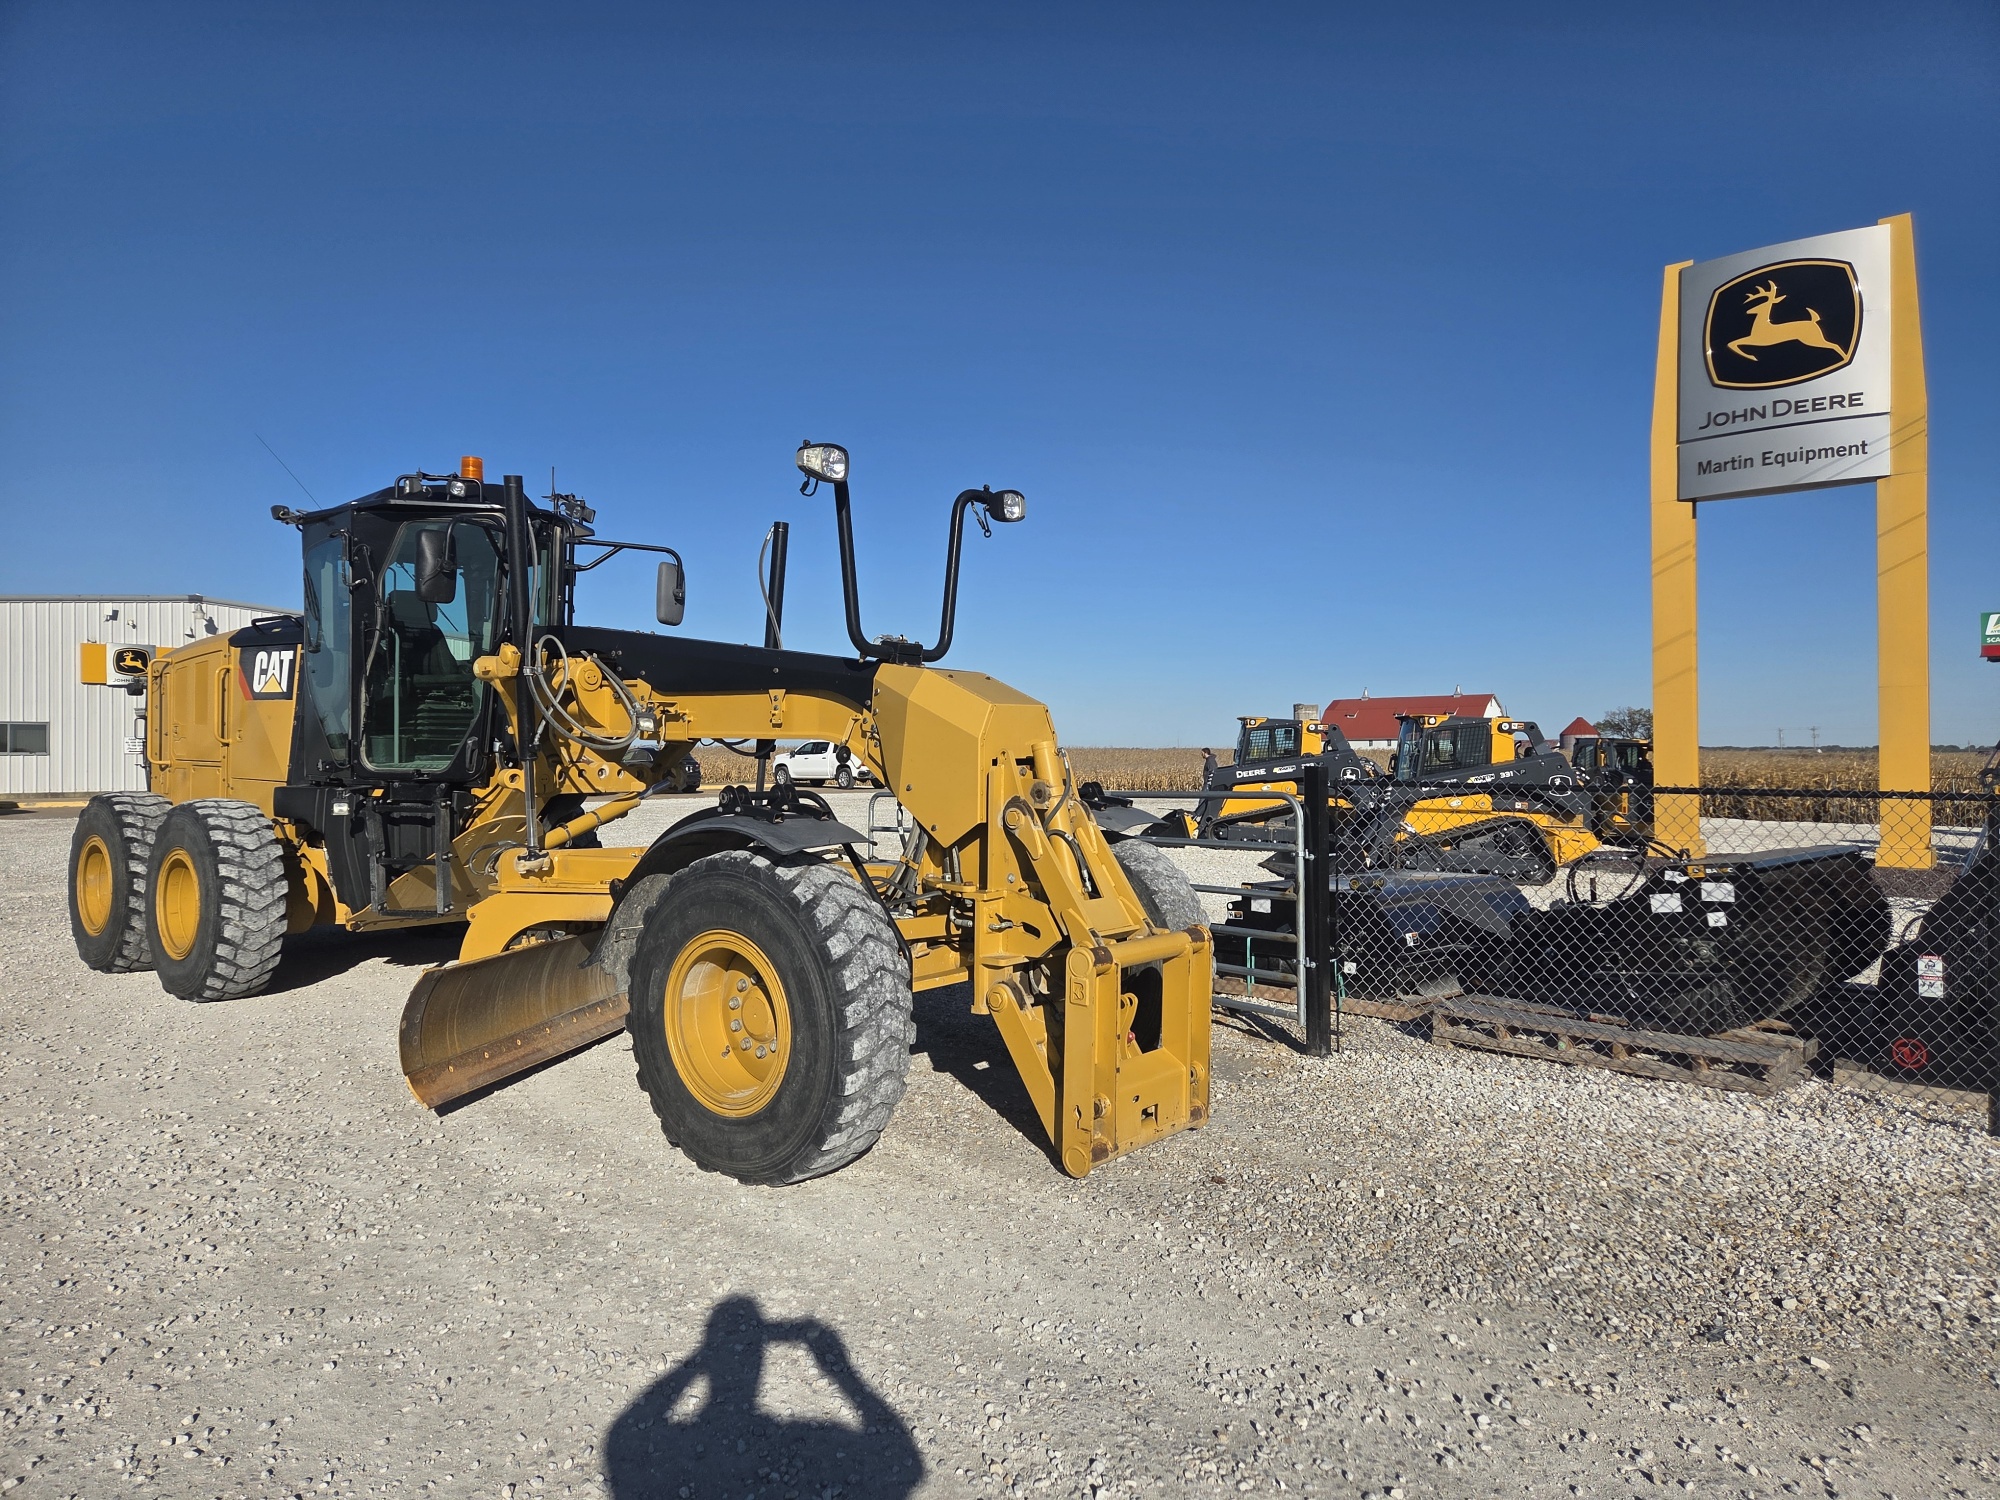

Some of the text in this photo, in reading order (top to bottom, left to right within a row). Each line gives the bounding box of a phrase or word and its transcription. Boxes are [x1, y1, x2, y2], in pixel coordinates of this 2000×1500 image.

[1698, 392, 1864, 430] JOHN DEERE
[1697, 440, 1868, 476] Martin Equipment
[252, 650, 294, 693] CAT
[1236, 768, 1267, 779] DEERE
[1499, 770, 1514, 779] 331
